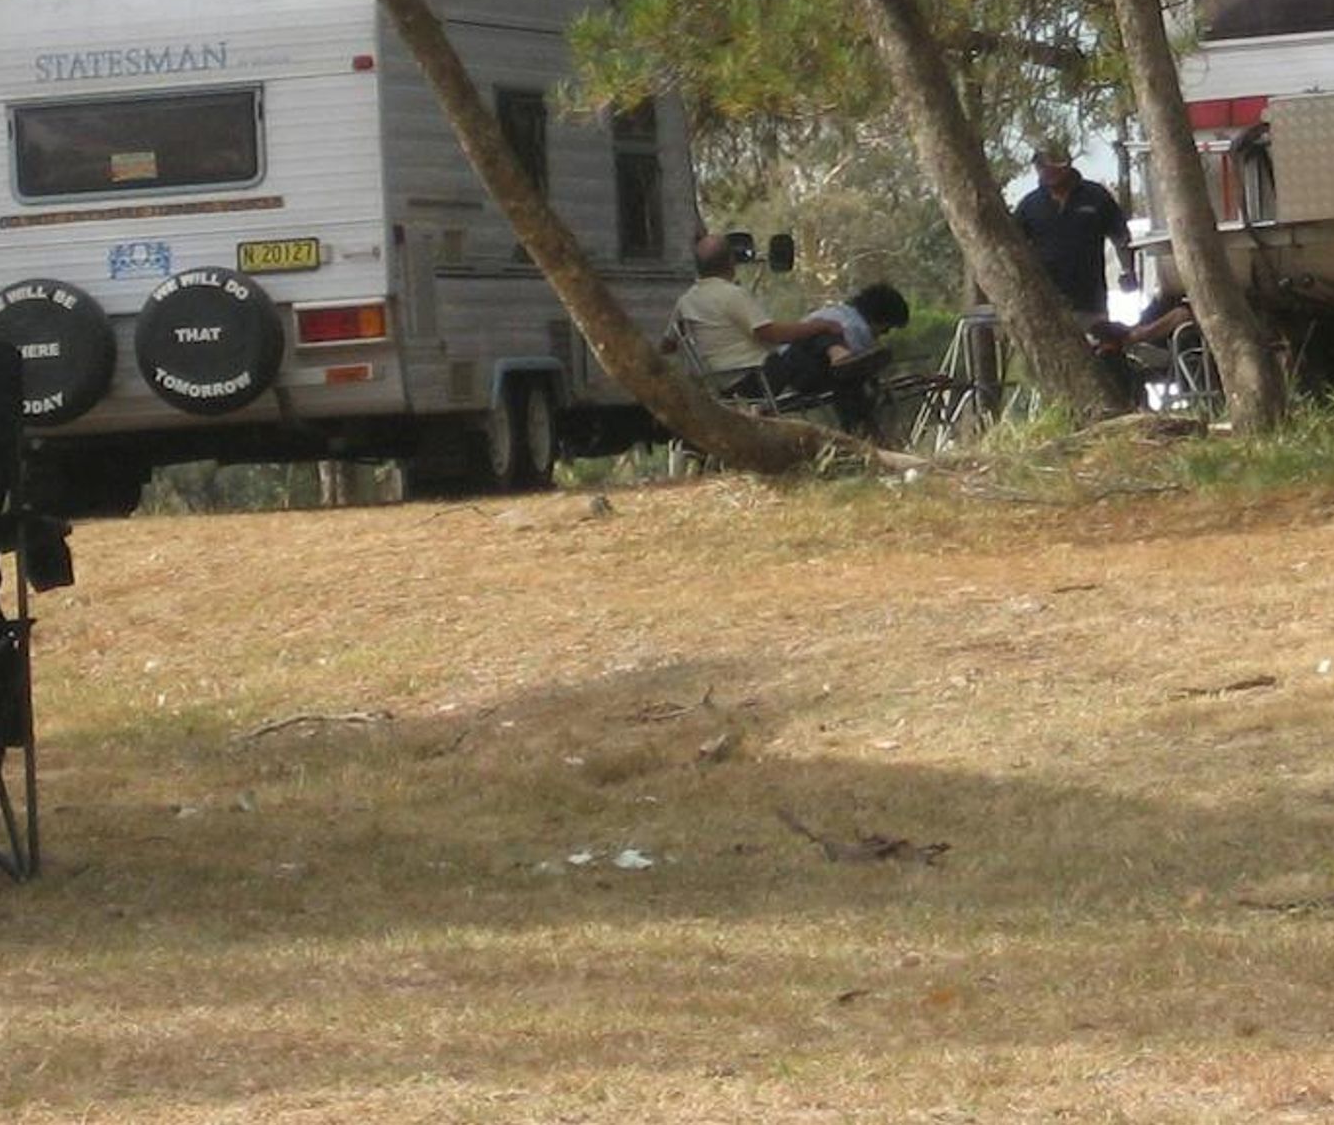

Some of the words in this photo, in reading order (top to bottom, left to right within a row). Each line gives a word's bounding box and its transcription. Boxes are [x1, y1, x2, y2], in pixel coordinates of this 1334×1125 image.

[35, 41, 227, 82] STATESMAN
[6, 285, 48, 304] WILL
[52, 288, 78, 309] BE
[153, 278, 179, 301] WE
[180, 272, 221, 287] WILL
[225, 279, 249, 300] DO
[175, 327, 222, 343] THAT
[154, 367, 251, 398] TOMORROW
[22, 391, 64, 415] ODAY
